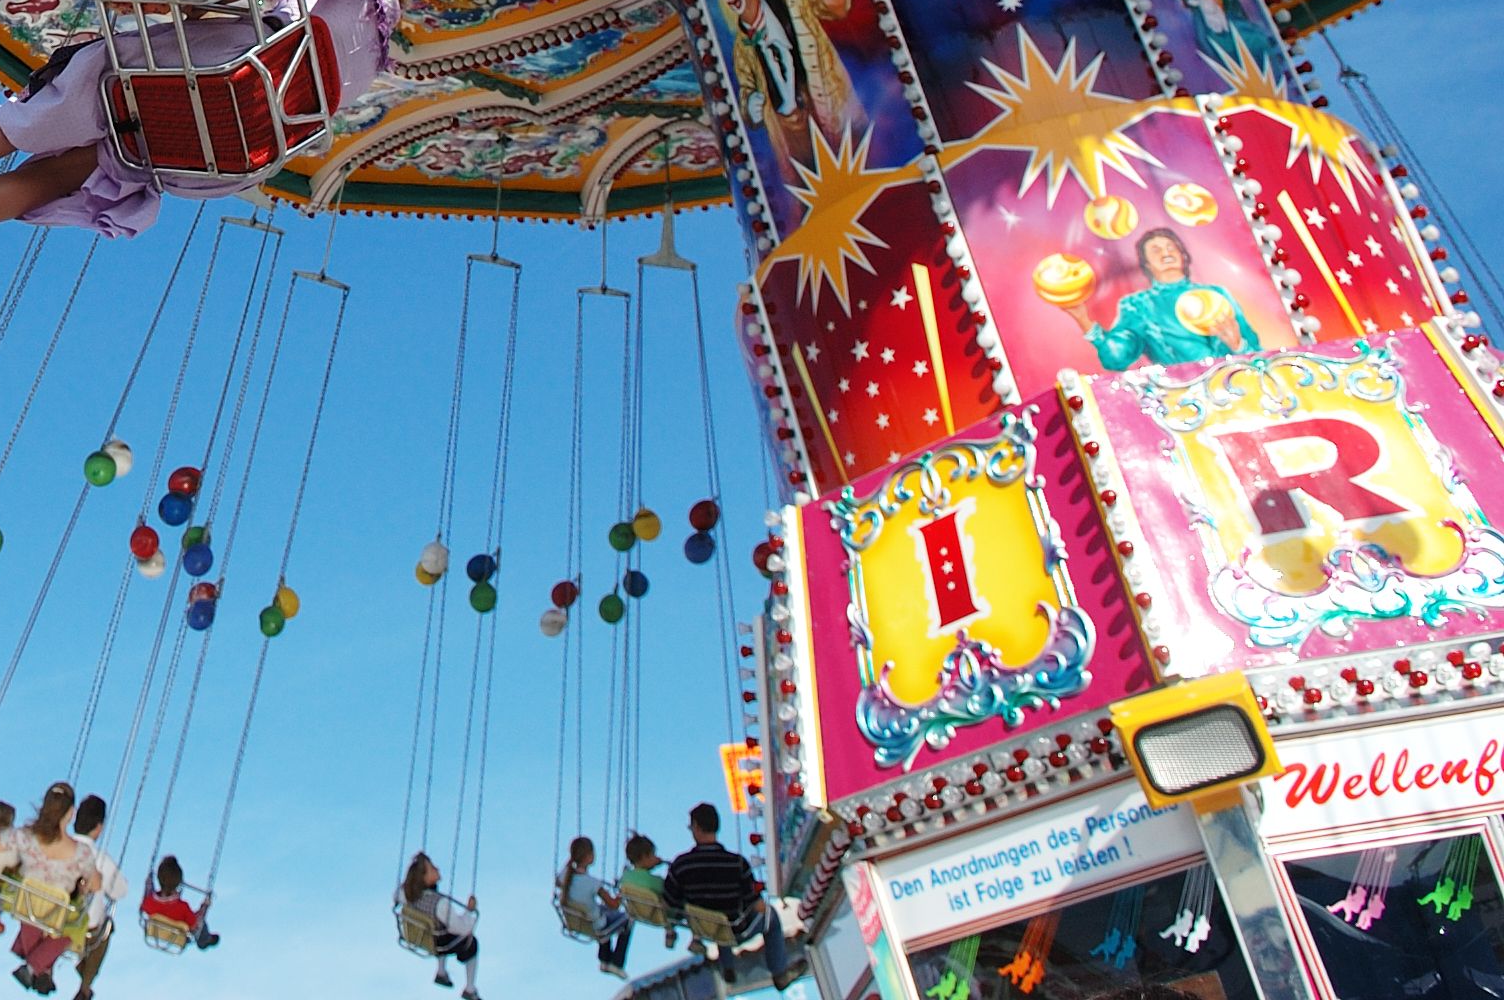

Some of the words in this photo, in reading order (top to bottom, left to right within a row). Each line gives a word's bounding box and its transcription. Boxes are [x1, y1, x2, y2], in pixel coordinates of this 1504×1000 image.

[1212, 418, 1410, 535] R
[889, 877, 925, 901] Den
[930, 836, 1042, 888] Anordnungen
[1047, 825, 1082, 851] des
[1085, 802, 1179, 836] Person
[946, 888, 971, 912] ist
[975, 874, 1025, 904] Folge
[1032, 866, 1053, 886] zu
[1059, 846, 1121, 879] leisten
[1122, 834, 1134, 857] !
